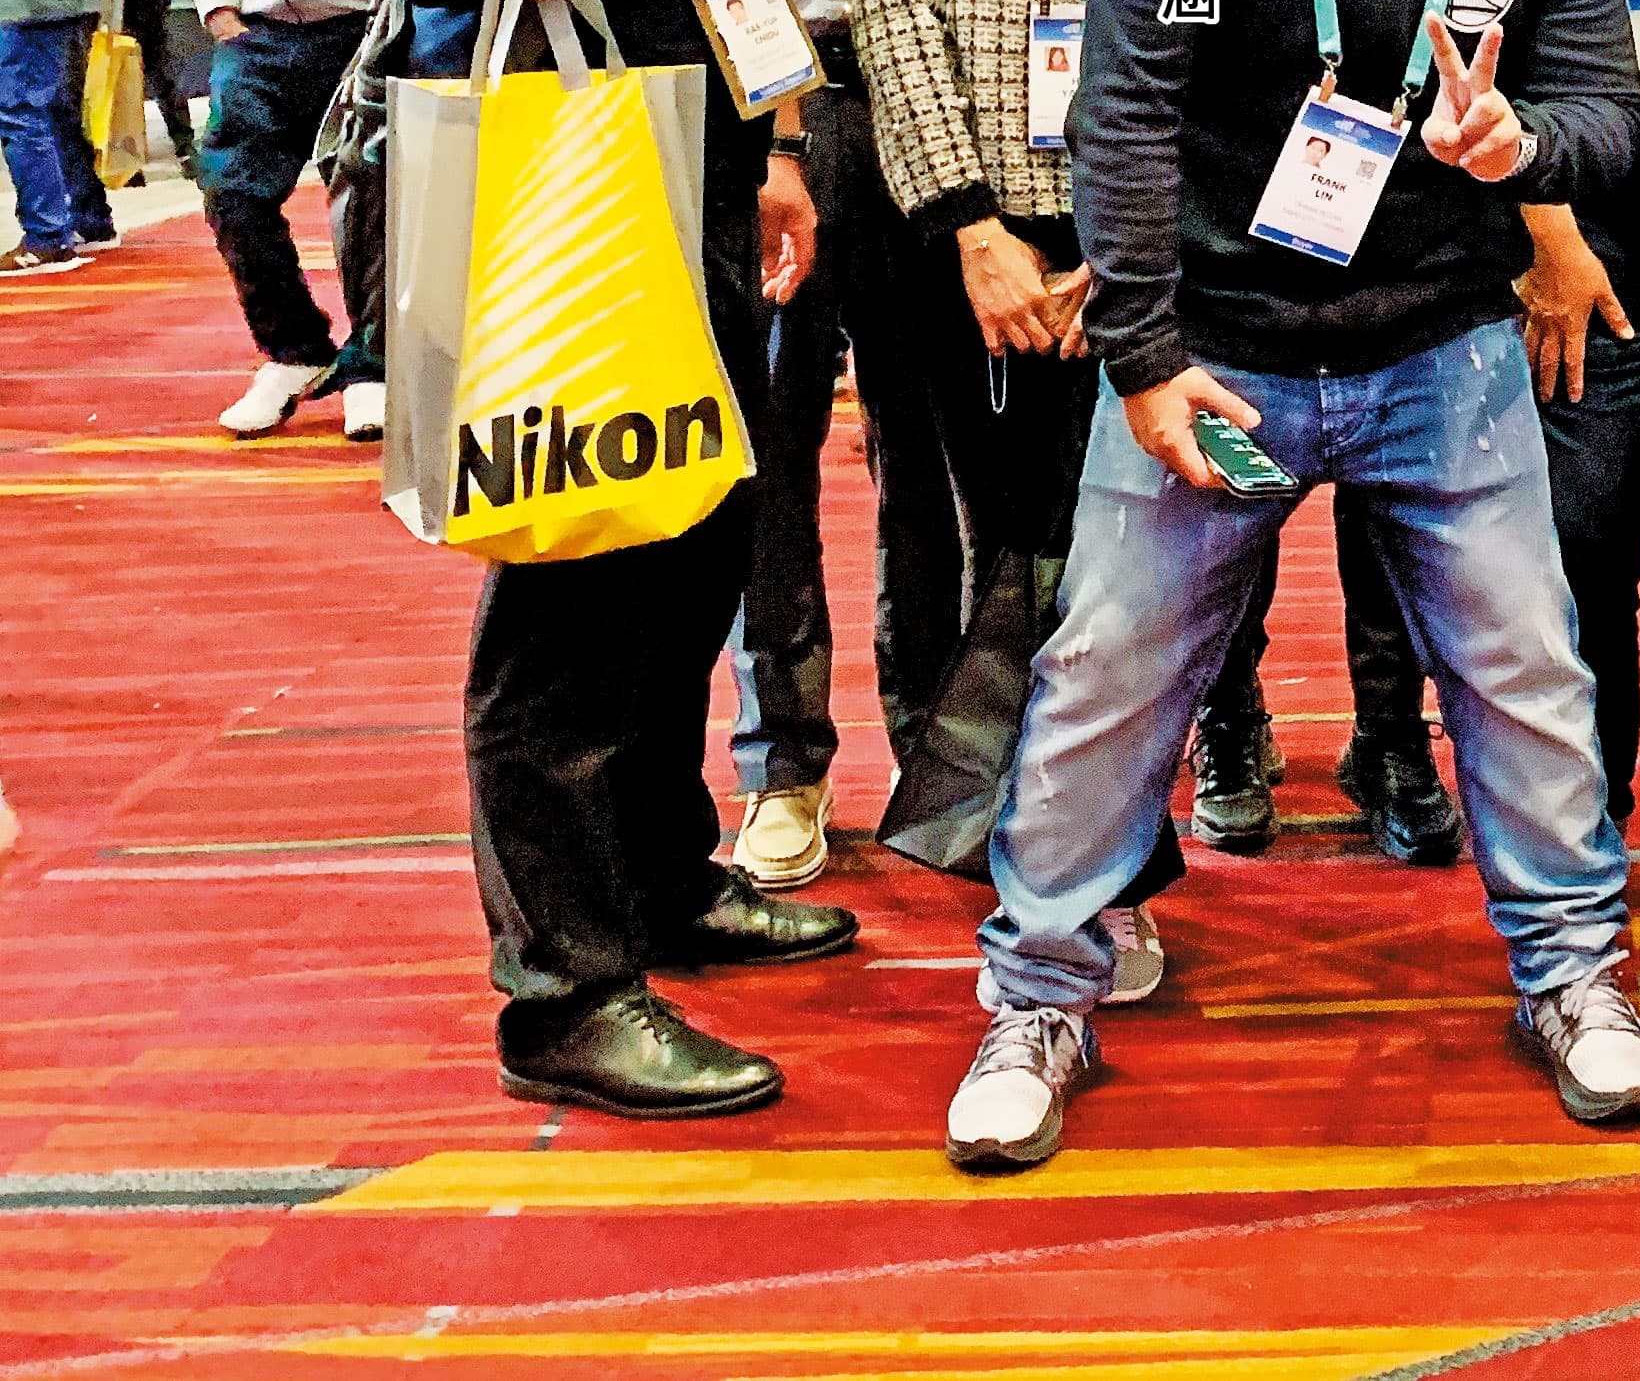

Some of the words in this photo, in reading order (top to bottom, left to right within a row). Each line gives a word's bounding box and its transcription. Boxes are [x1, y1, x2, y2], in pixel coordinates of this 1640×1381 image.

[1311, 173, 1348, 192] FRANK
[1315, 190, 1334, 202] LIN
[453, 397, 723, 517] Nikon
